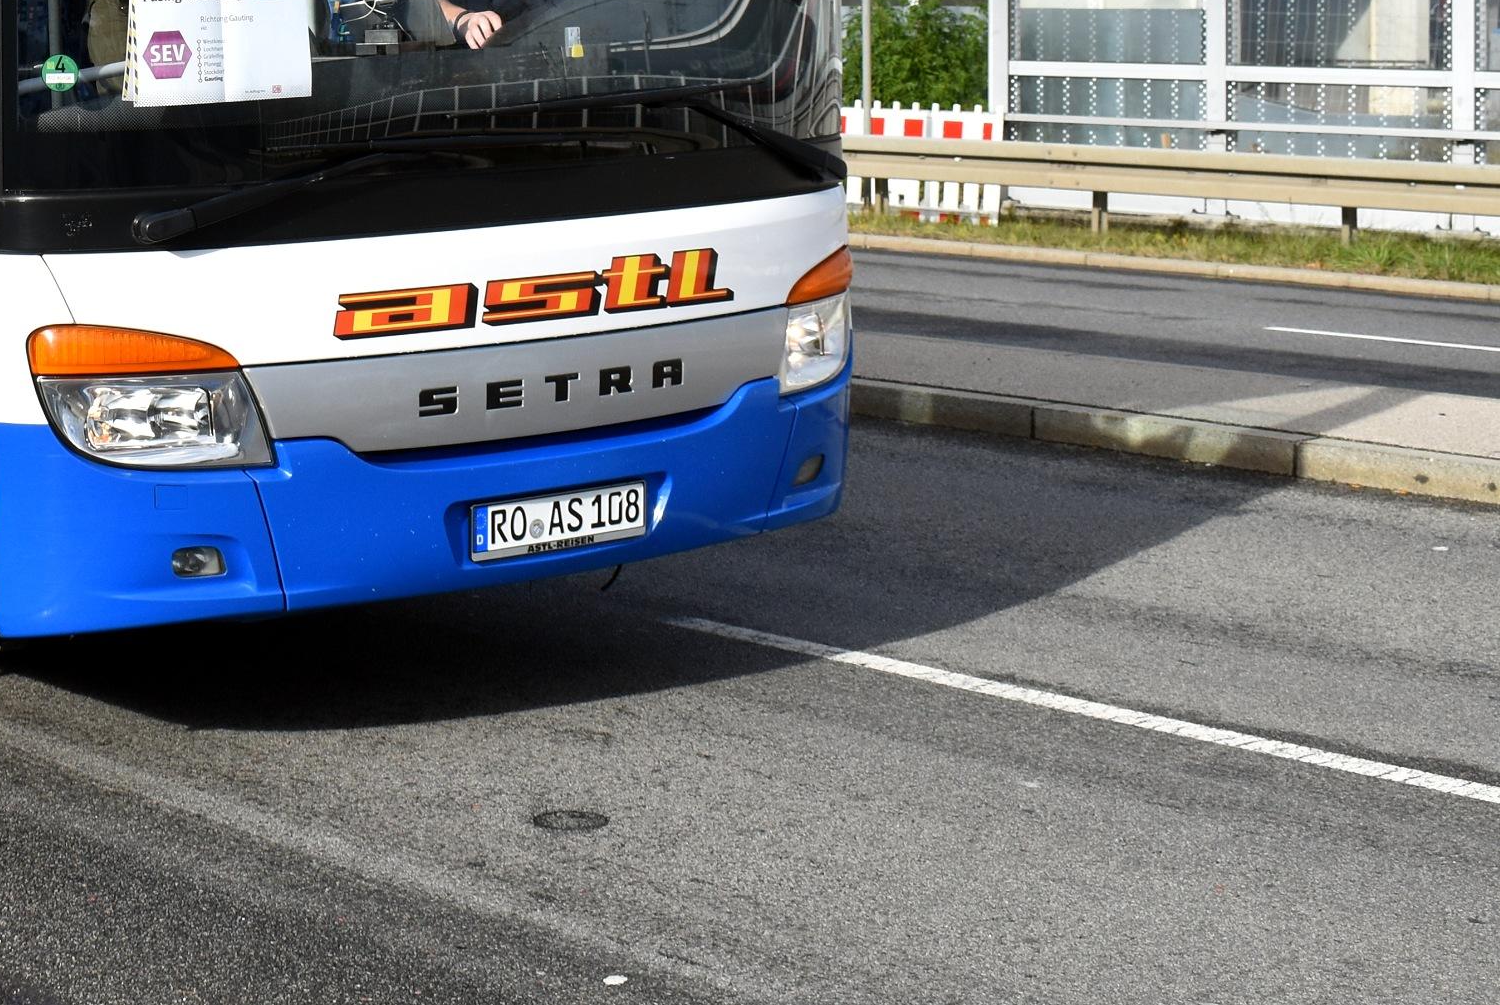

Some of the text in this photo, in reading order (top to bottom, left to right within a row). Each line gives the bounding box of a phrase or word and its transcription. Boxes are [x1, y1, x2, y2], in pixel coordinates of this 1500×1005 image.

[55, 56, 66, 73] 4
[150, 44, 185, 63] SEV
[333, 247, 734, 340] astl
[418, 358, 684, 417] SETRA
[491, 488, 640, 544] RO AS 108
[527, 534, 595, 553] ASTL-REISEN
